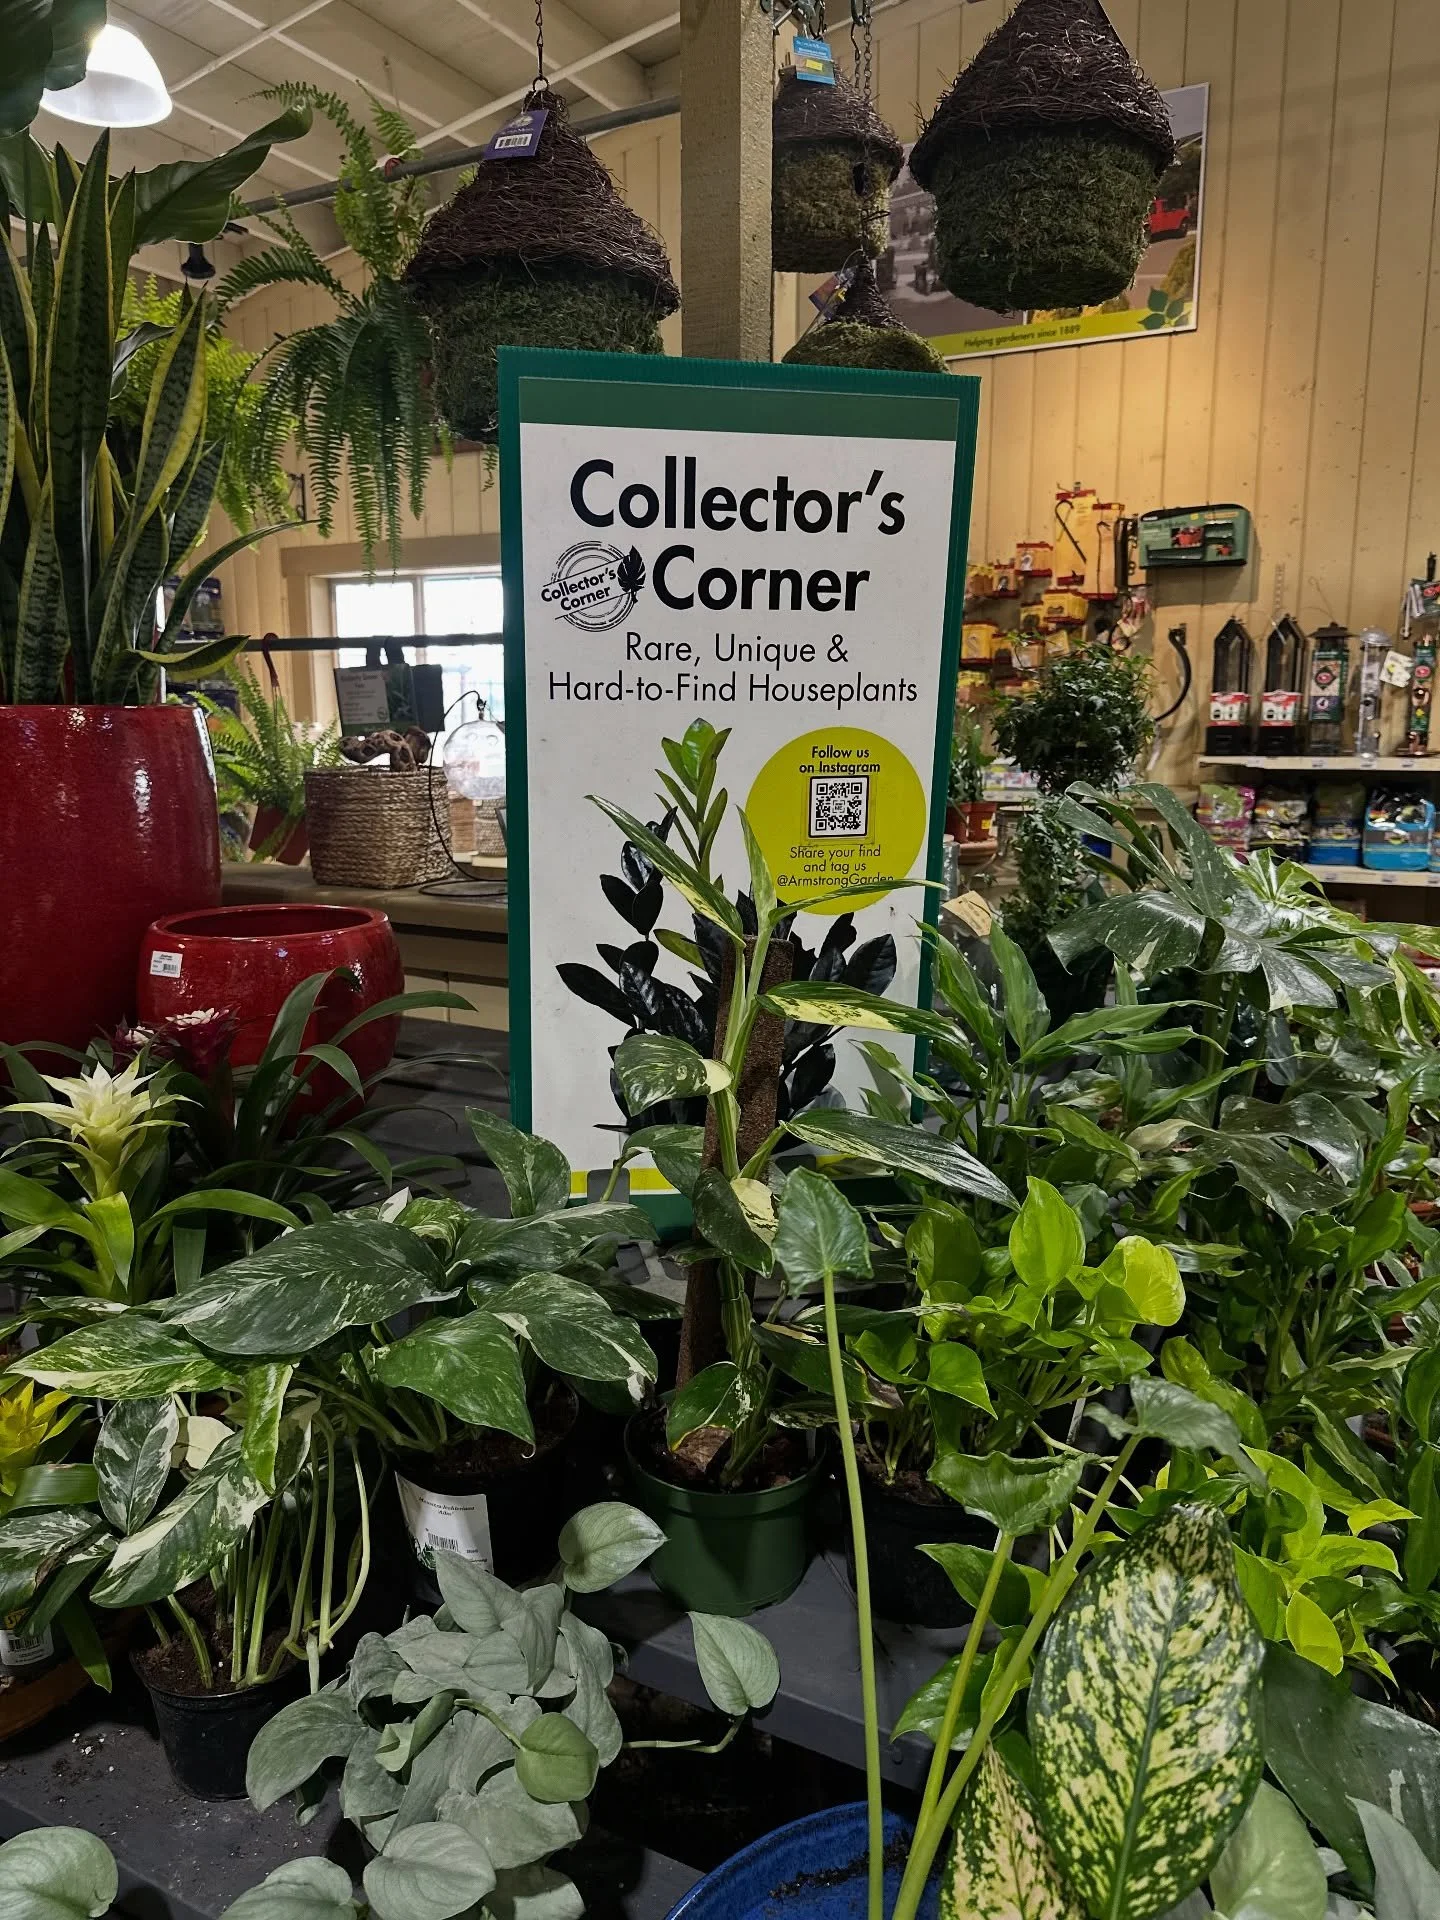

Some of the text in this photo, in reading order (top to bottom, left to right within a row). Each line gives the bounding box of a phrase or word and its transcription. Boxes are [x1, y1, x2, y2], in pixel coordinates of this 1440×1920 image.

[964, 324, 1081, 347] Helping gardeners since 1889
[570, 456, 905, 535] Collector's
[541, 567, 616, 602] Collector's
[652, 545, 870, 612] Corner
[560, 586, 611, 611] Corner
[626, 632, 848, 671] Rare, Unique &
[550, 670, 917, 710] Hard-to-Find Houseplants
[811, 745, 870, 759] Follow us
[799, 761, 881, 775] on Instagram
[789, 844, 881, 862] Share your find
[803, 859, 867, 875] and tag us
